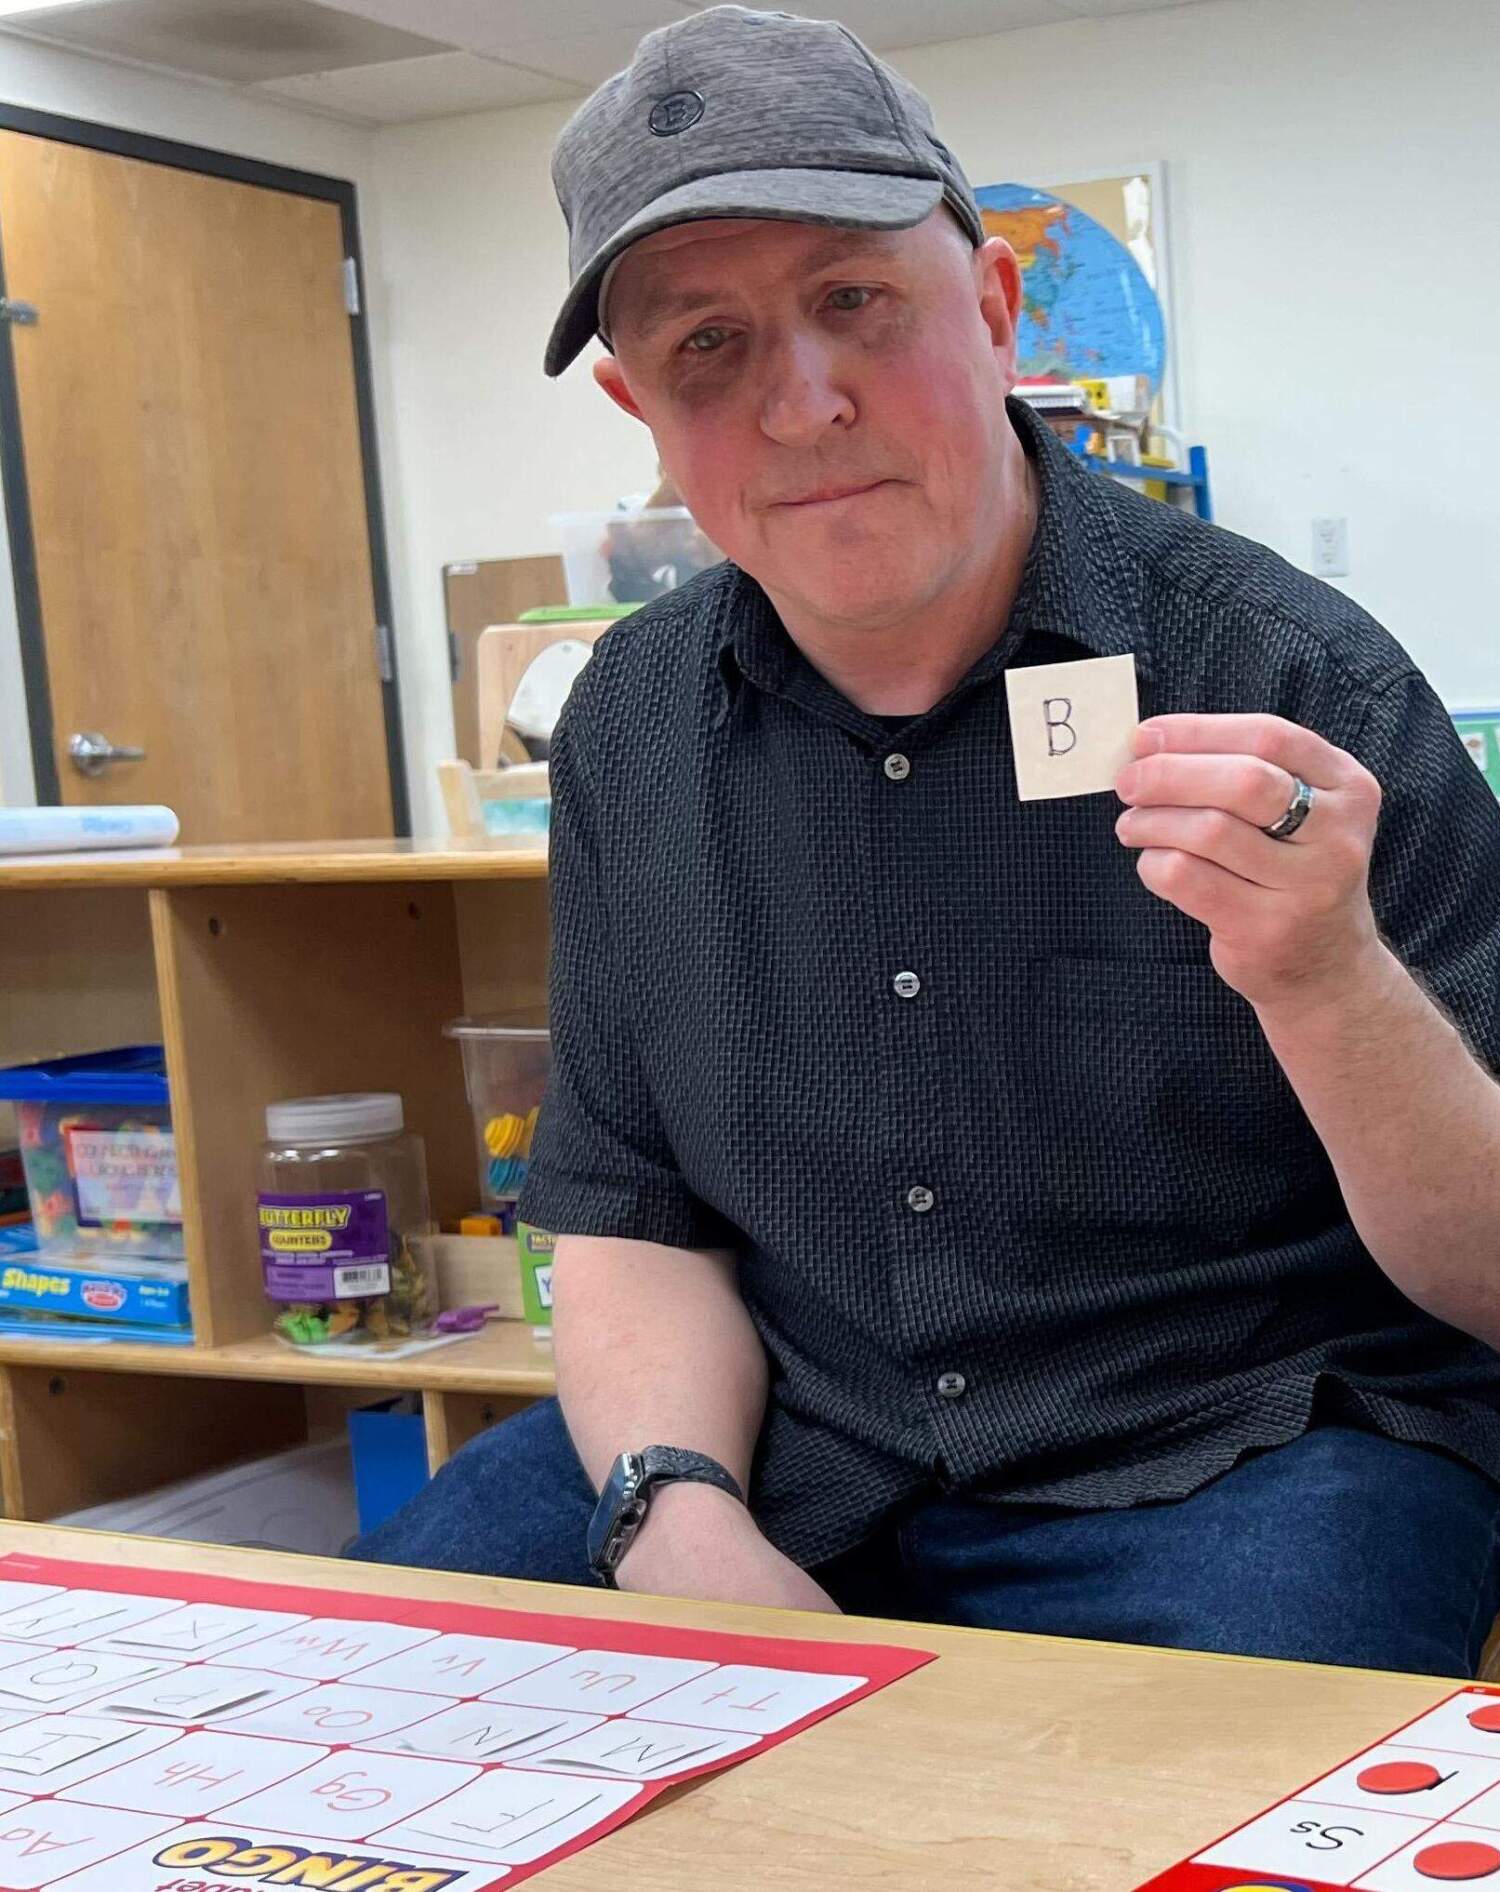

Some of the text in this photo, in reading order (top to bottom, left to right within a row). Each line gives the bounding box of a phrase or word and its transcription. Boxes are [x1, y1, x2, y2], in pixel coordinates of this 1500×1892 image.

[1043, 697, 1076, 757] B
[2, 1268, 71, 1297] Shapes
[432, 1654, 486, 1677] Vv
[569, 1668, 638, 1694] Uu
[700, 1686, 781, 1712] Tt
[303, 1706, 372, 1729] Oo
[154, 1761, 244, 1792] Hh
[311, 1771, 392, 1811] Gg
[450, 1798, 555, 1833] F
[1289, 1820, 1364, 1850] Ss
[153, 1836, 469, 1892] BINGO
